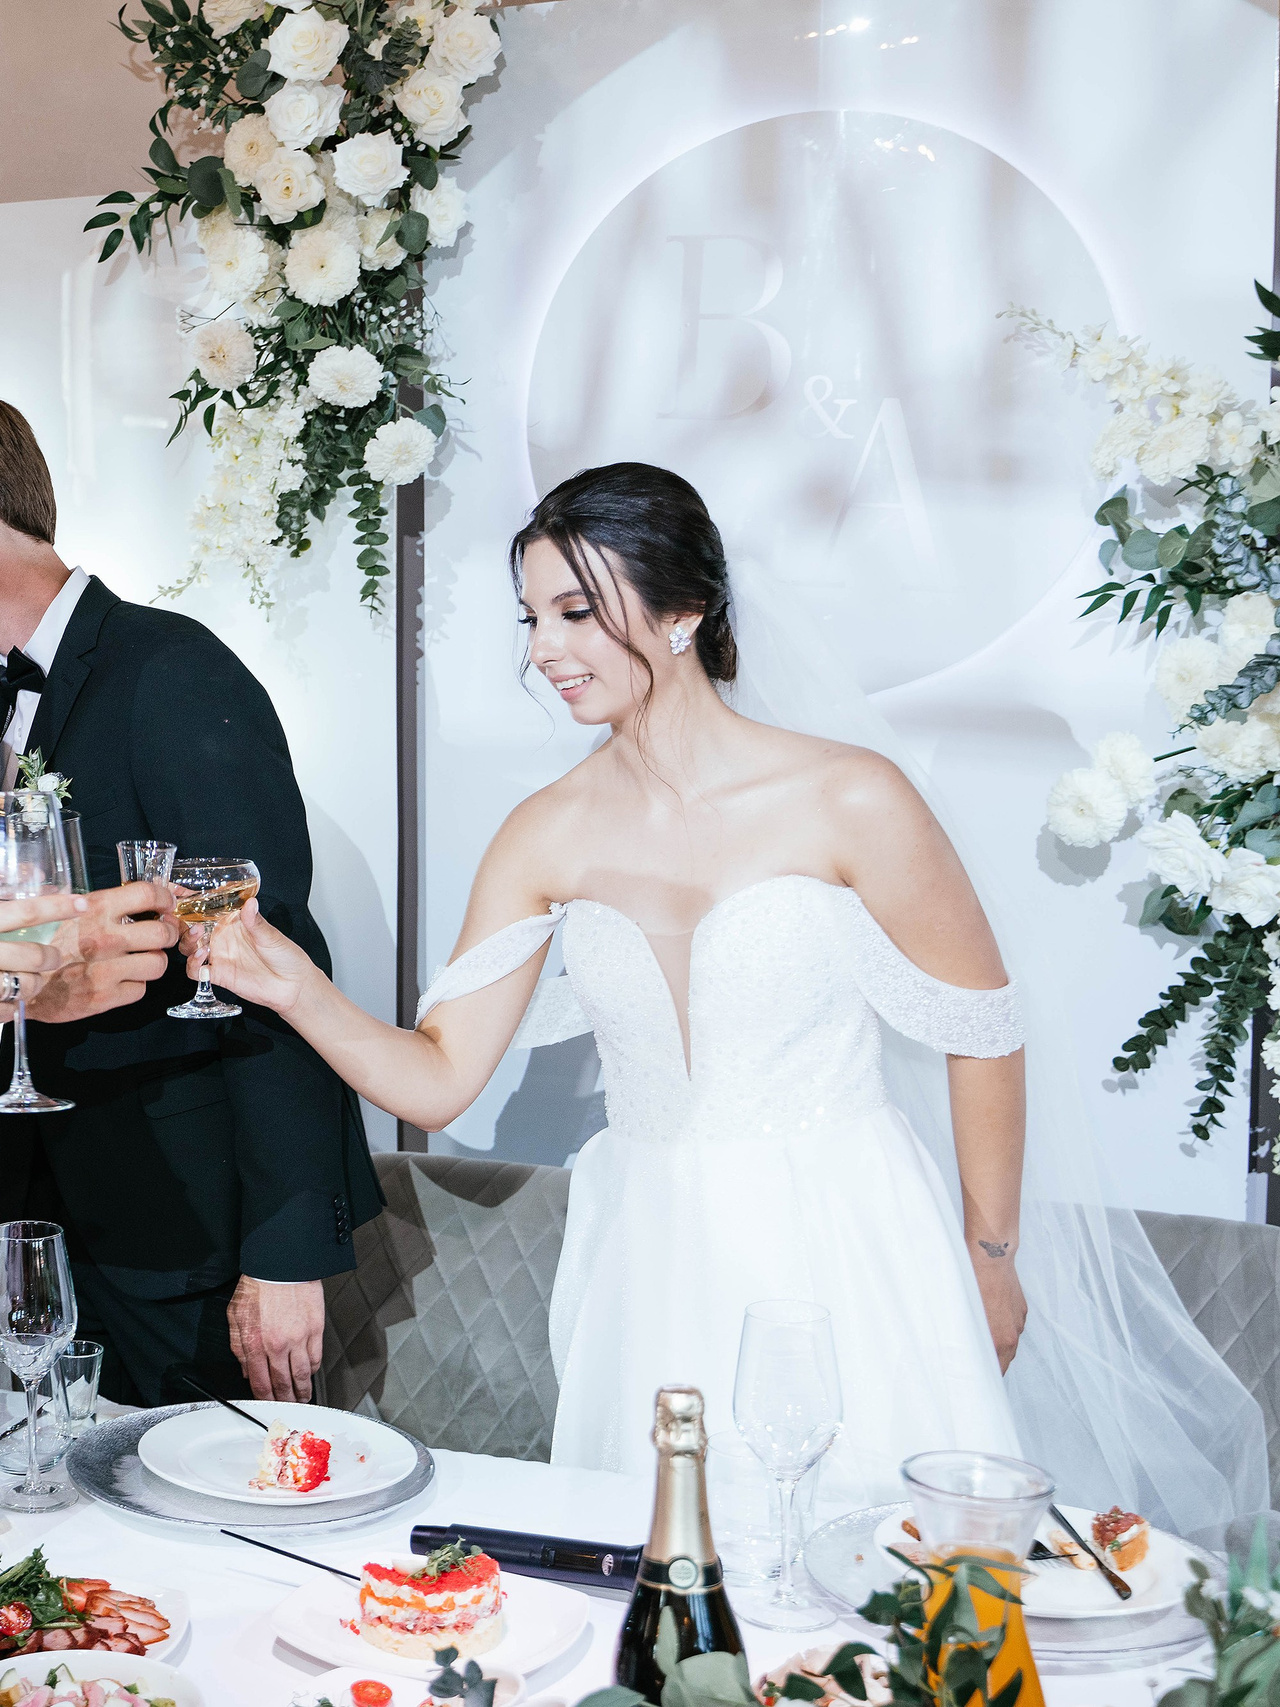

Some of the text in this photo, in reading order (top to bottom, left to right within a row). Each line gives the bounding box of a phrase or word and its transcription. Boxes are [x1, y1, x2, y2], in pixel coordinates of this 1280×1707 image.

[656, 234, 966, 592] B & A
